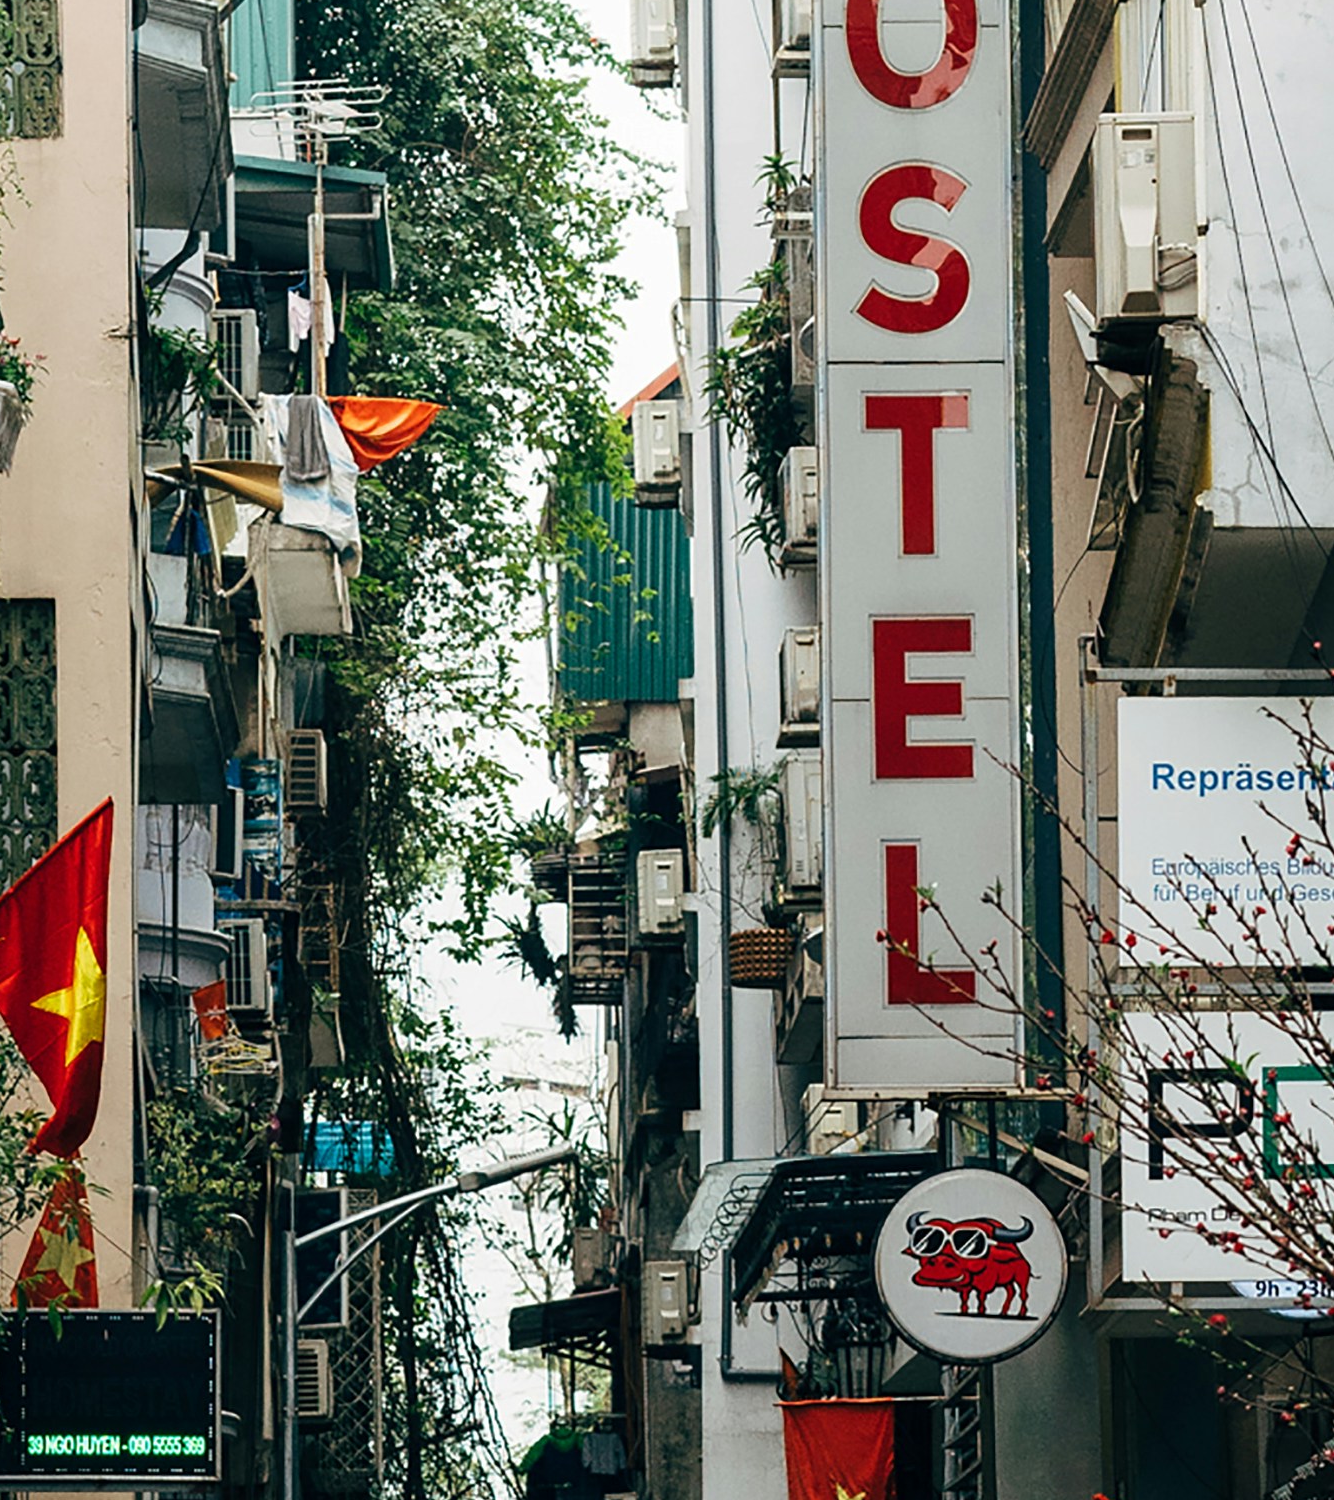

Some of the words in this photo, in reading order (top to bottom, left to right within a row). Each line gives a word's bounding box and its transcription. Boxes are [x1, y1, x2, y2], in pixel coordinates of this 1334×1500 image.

[1254, 1279, 1280, 1298] 9h
[27, 1434, 44, 1456] 39
[45, 1434, 75, 1456] NGO
[76, 1434, 121, 1456] HUYEN
[128, 1434, 151, 1456] 090
[152, 1434, 182, 1456] 5555
[183, 1434, 206, 1456] 369
